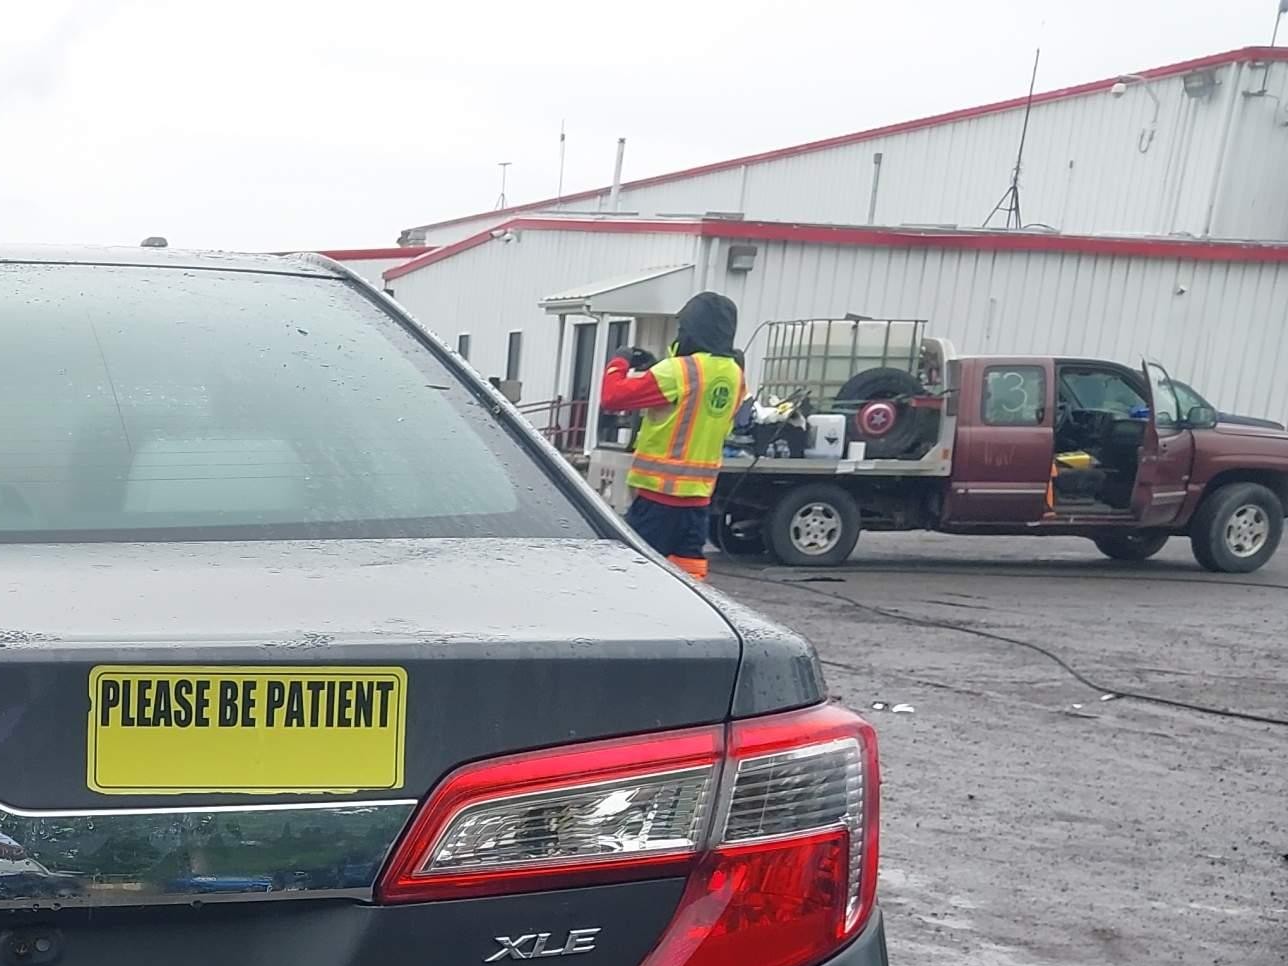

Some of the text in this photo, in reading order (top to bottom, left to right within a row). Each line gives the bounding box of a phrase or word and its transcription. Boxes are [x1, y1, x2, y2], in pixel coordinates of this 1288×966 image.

[101, 679, 394, 728] PLEASE BE PATIENT
[484, 927, 602, 962] XLE
